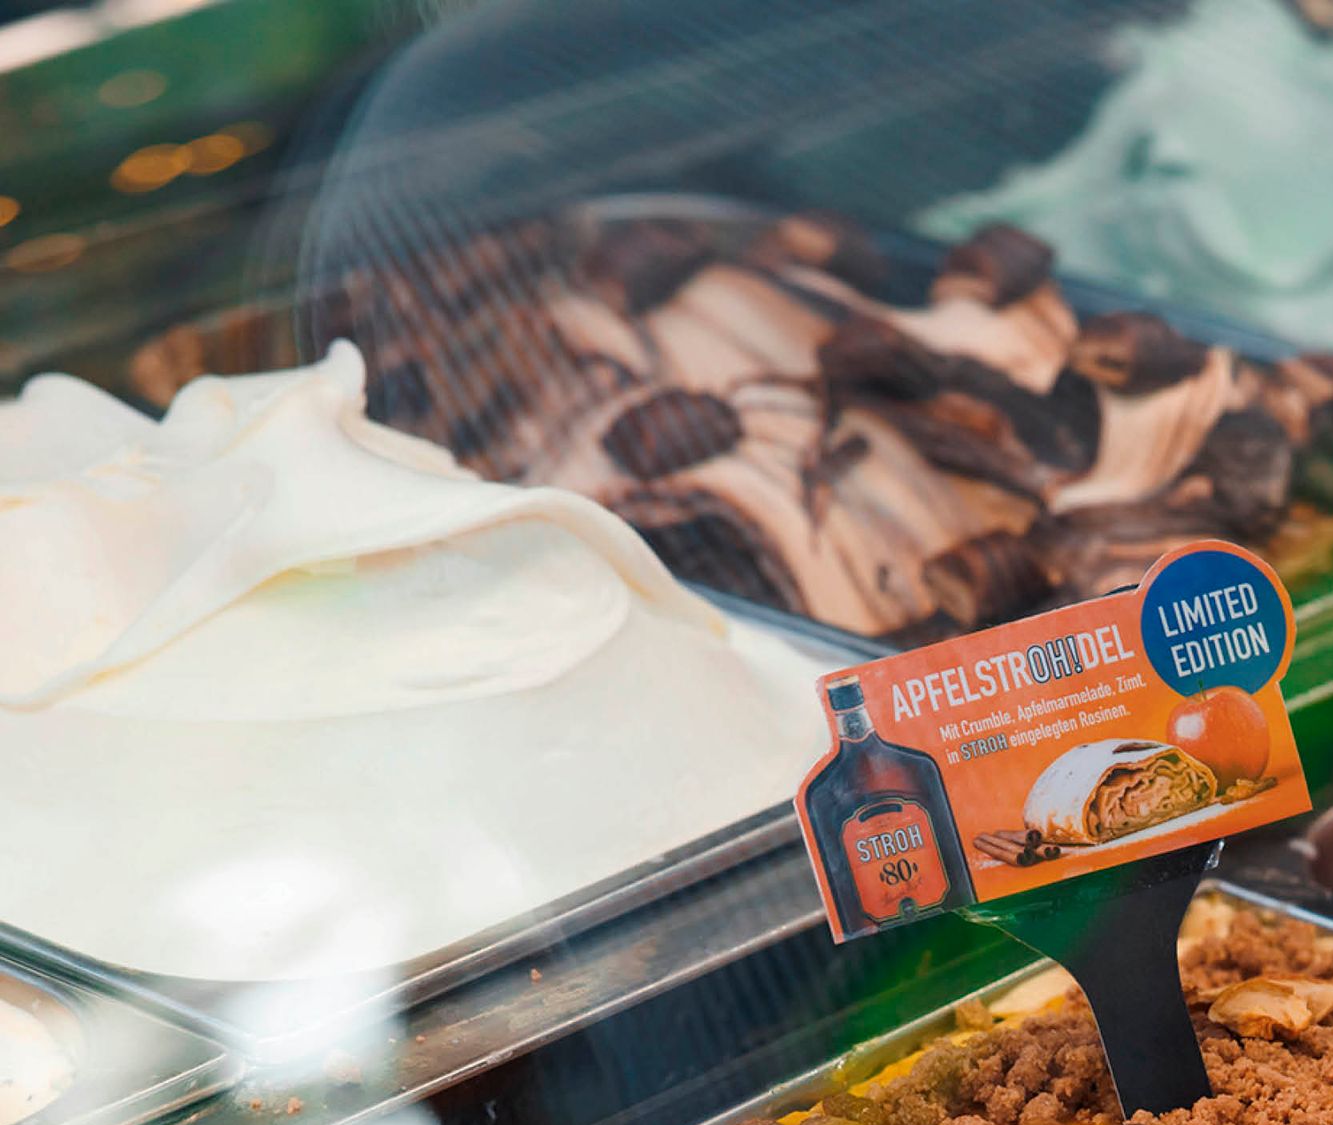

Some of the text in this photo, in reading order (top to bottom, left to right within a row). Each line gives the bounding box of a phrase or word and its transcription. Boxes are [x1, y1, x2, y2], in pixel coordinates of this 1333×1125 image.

[1158, 582, 1258, 637] LIMITED
[892, 624, 1135, 722] APFELSTROH!DEL
[1170, 622, 1270, 678] EDITION
[939, 725, 960, 742] Mit
[945, 749, 960, 765] in
[960, 734, 1009, 761] STROH
[1009, 716, 1079, 748] eingelegten
[856, 824, 924, 863] STROH
[882, 859, 913, 886] 80
